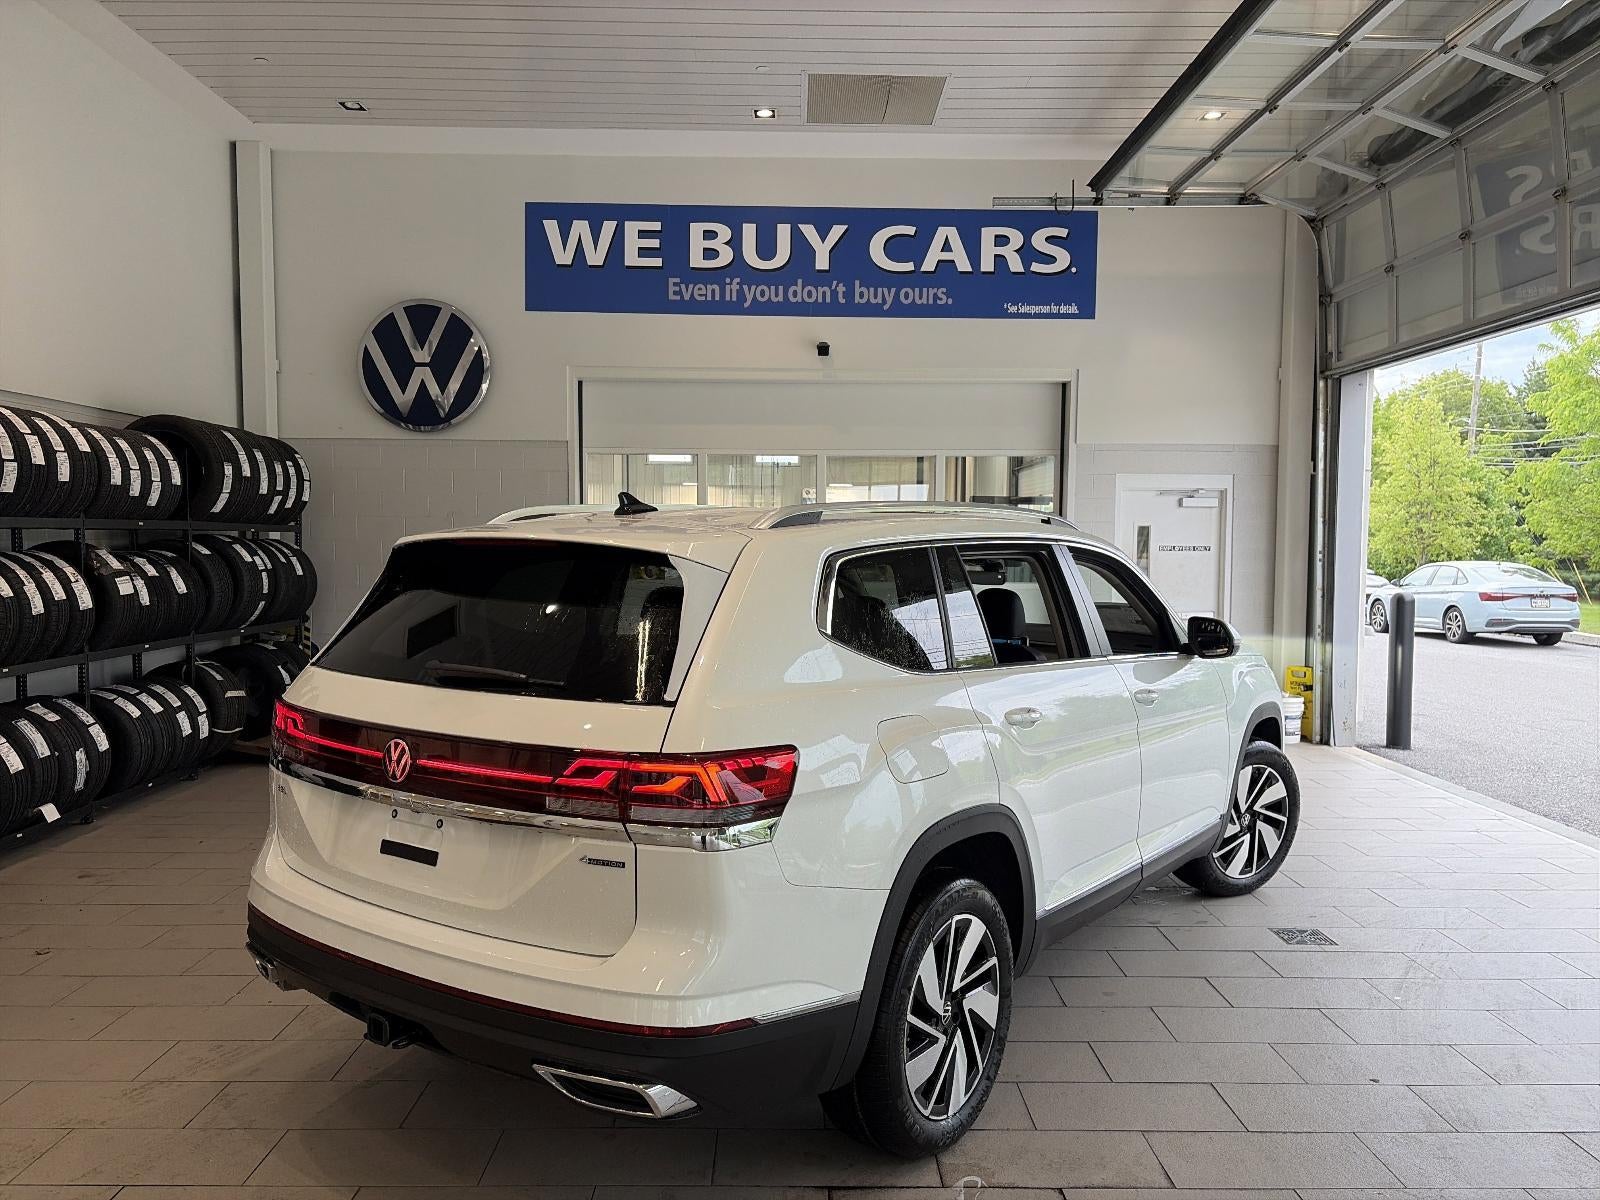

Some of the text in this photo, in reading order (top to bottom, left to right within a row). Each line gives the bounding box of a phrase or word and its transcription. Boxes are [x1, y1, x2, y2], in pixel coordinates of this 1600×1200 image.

[542, 219, 1078, 275] WE BUY CARS.
[668, 277, 720, 301] Even
[724, 278, 741, 301] if
[742, 284, 784, 308] you
[854, 280, 896, 310] buy
[899, 287, 953, 305] ours.
[1018, 302, 1051, 316] Salesperson
[1051, 302, 1060, 314] for
[1059, 302, 1079, 314] details.
